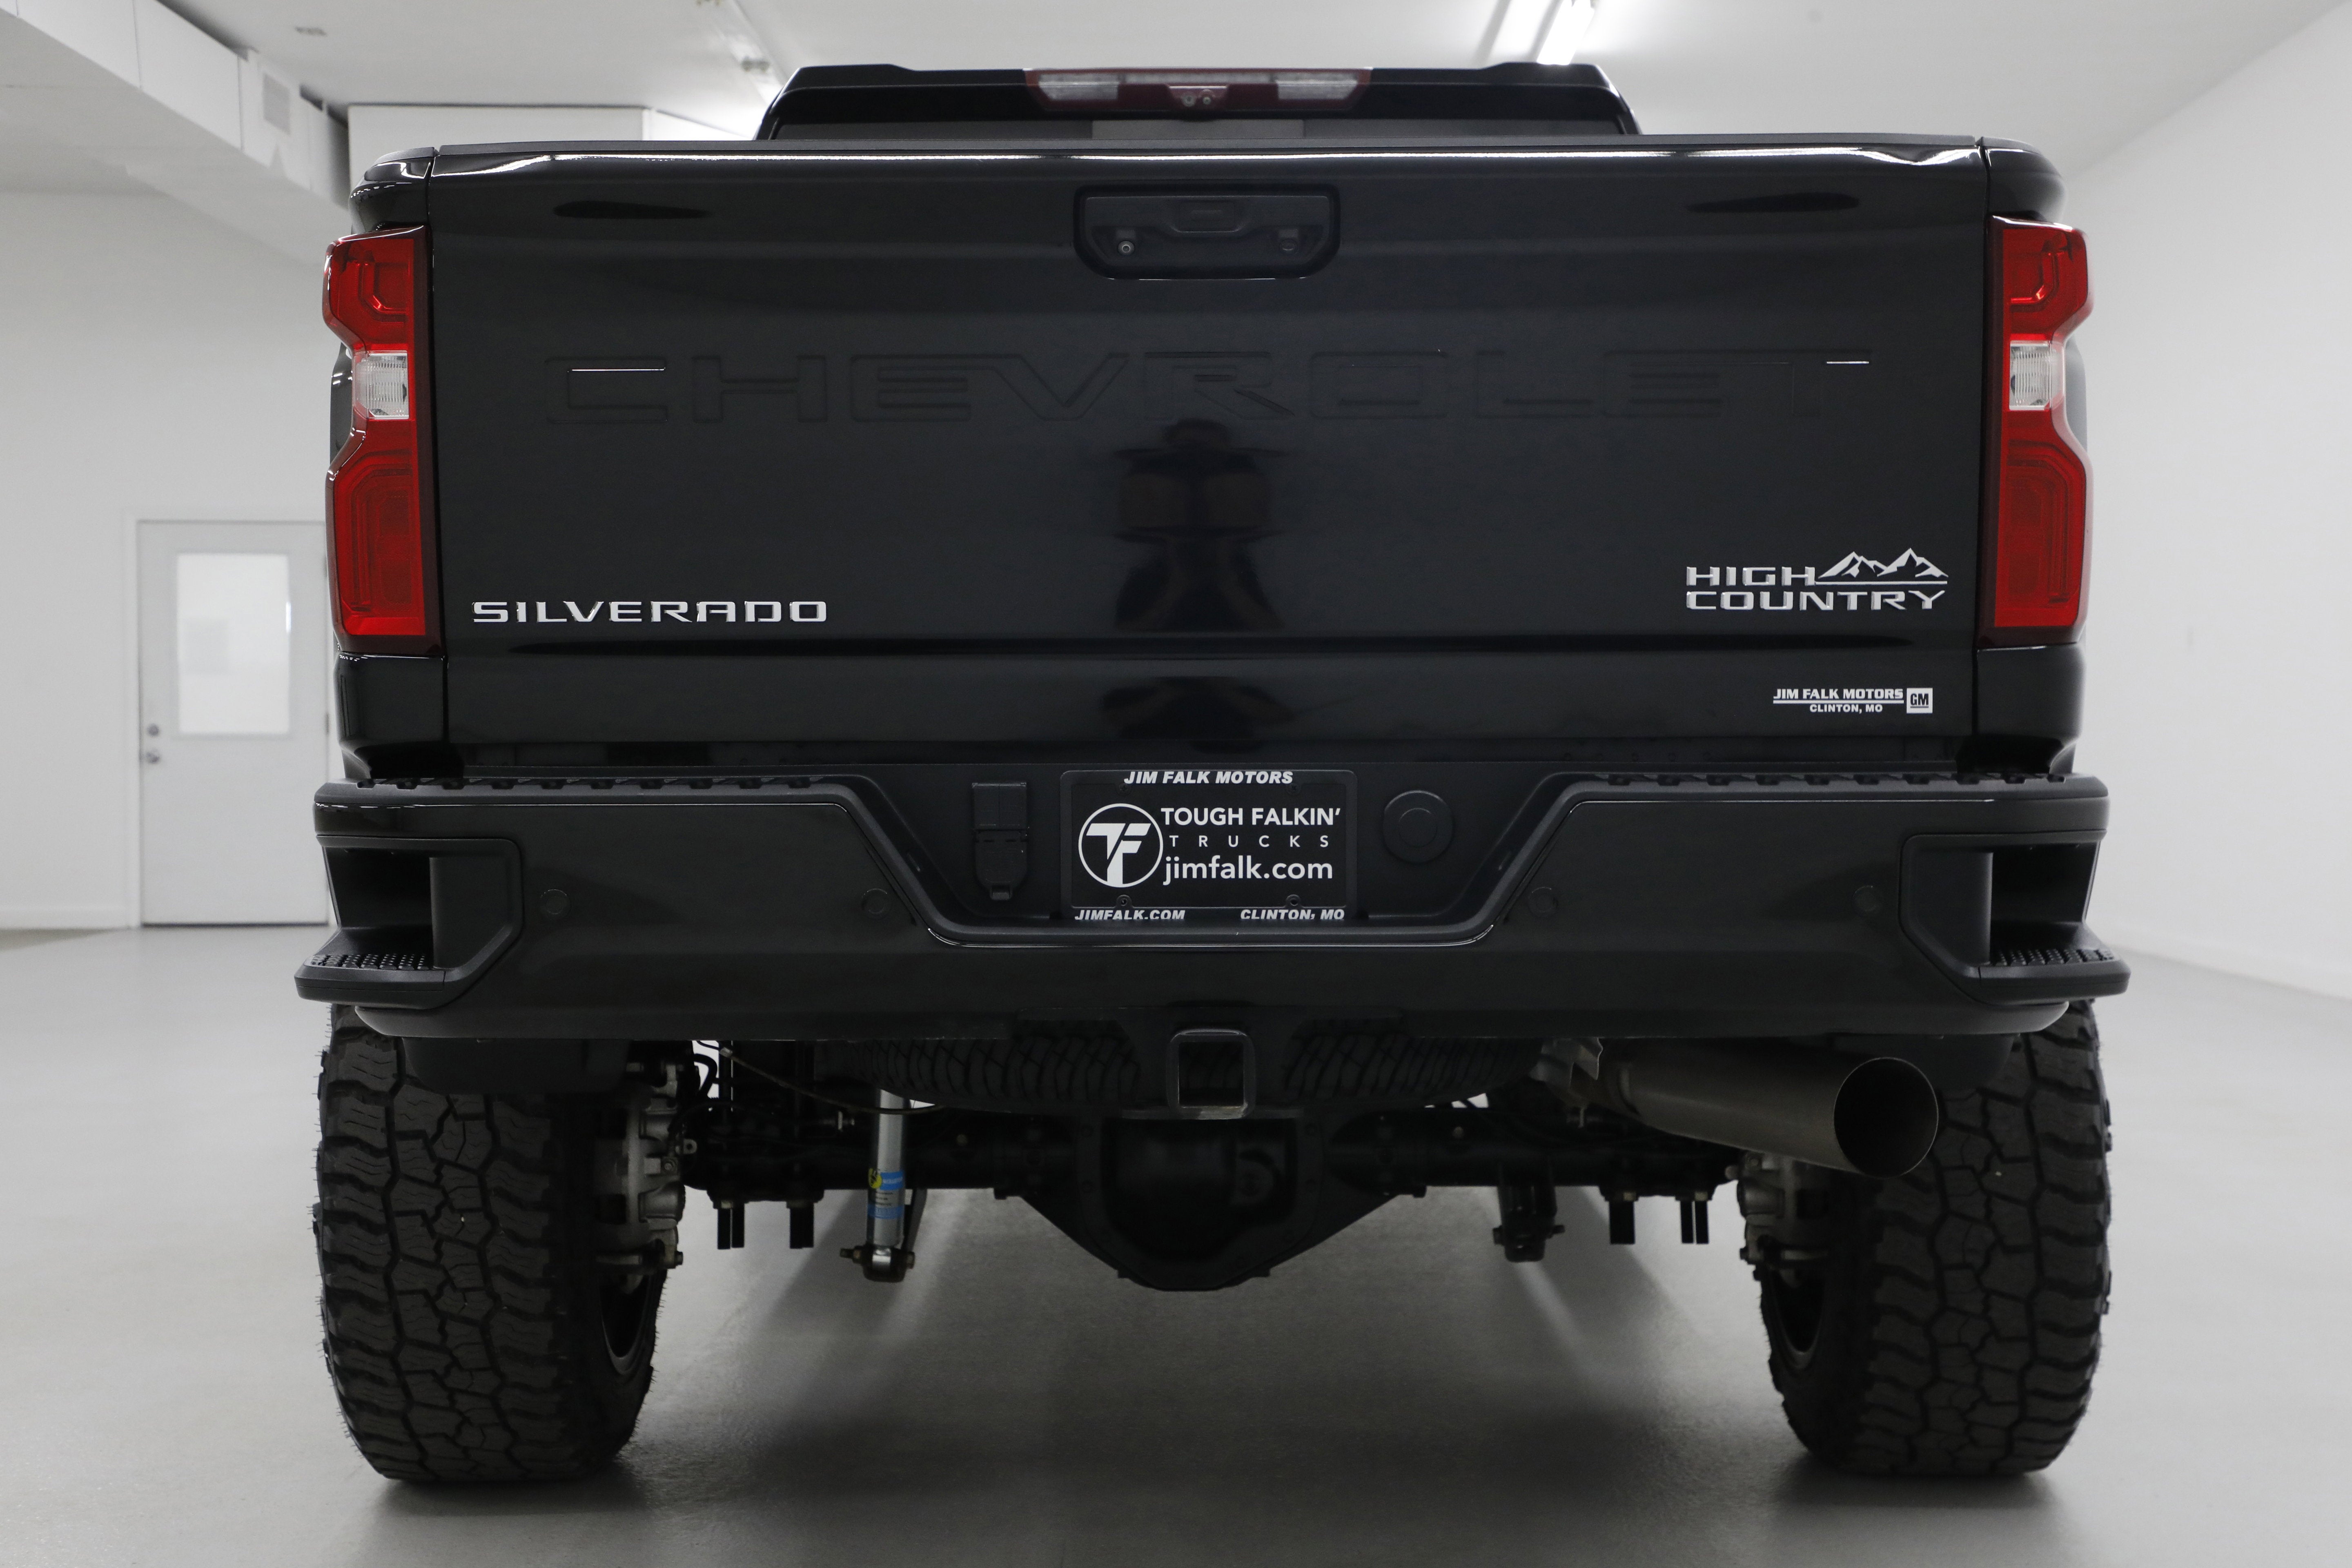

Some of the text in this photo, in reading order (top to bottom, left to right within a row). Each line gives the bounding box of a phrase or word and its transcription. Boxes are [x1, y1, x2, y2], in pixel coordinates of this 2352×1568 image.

[544, 350, 1873, 424] CHEVROLET
[1686, 566, 1816, 586] HIGH
[1686, 590, 1946, 611] COUNTRY
[471, 601, 827, 623] SILVERADO
[1773, 688, 1904, 699] JIM FALK MOTORS
[1910, 693, 1929, 706] GM
[1809, 704, 1883, 714] CLINTON, MO
[1124, 770, 1293, 784] JIM FALK MOTORS
[1160, 807, 1243, 826] TOUGH
[1163, 855, 1333, 886] jimfalk.com
[1074, 909, 1185, 920] JIMFALK.COM
[1240, 909, 1345, 920] CLINTON, MO
